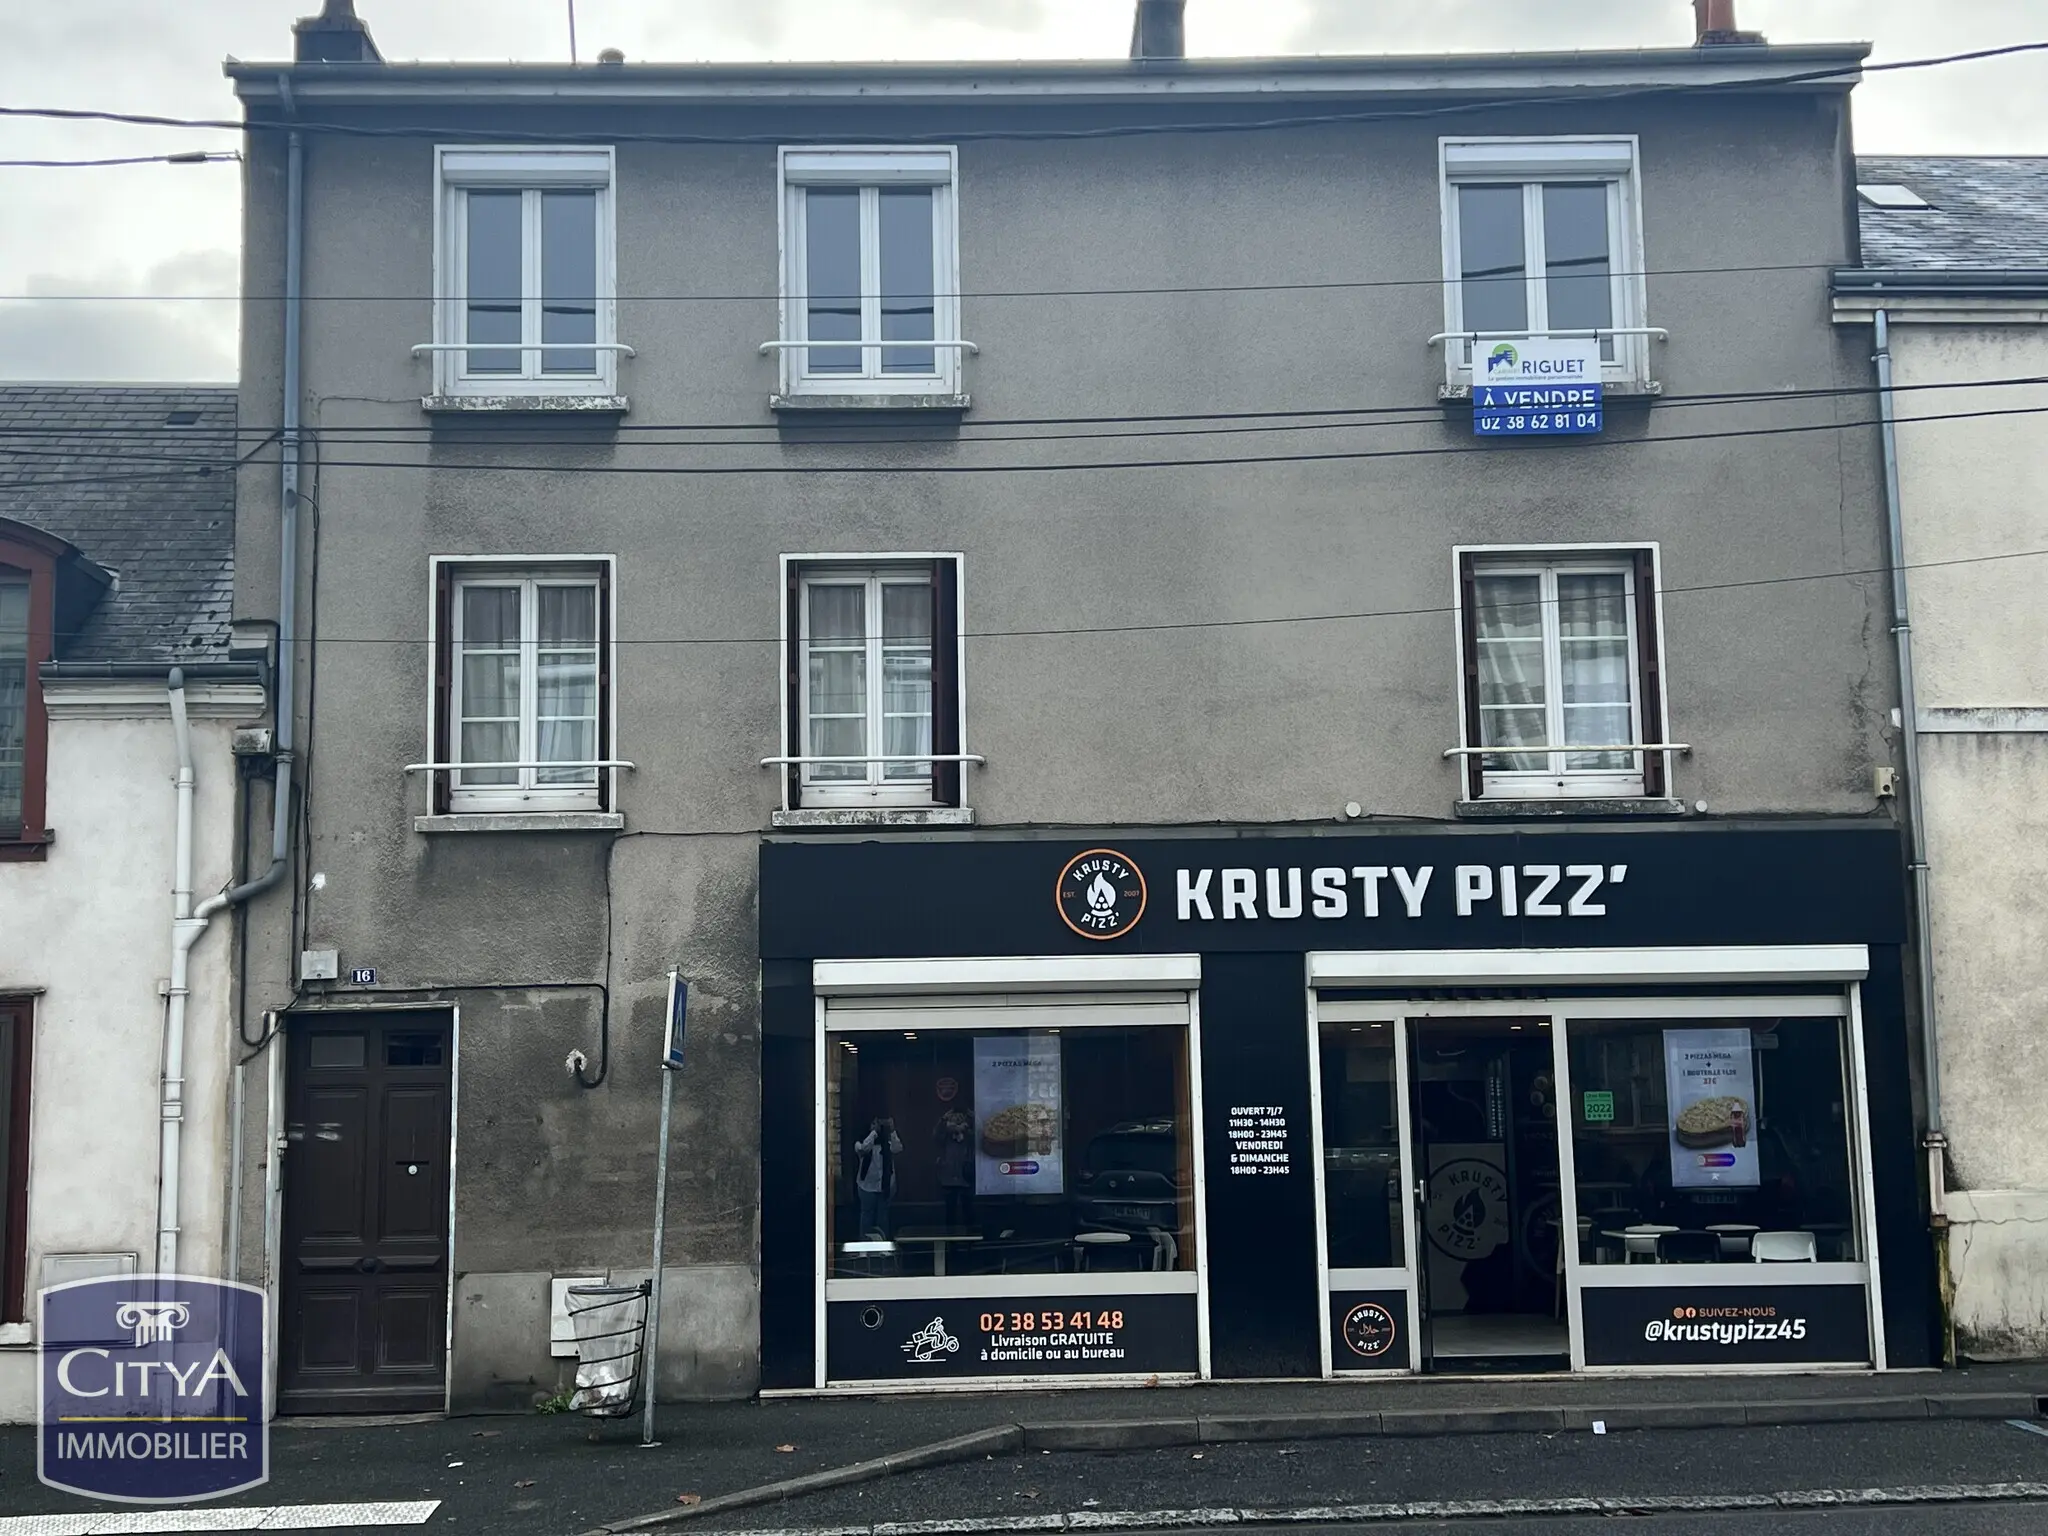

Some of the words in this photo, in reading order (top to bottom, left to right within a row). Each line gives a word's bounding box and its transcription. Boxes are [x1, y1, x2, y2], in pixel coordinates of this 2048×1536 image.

[1522, 358, 1584, 374] RIGUET
[1484, 388, 1494, 410] À
[1504, 389, 1596, 409] VENDRE
[1482, 416, 1500, 430] 02
[1507, 415, 1524, 430] 38
[1530, 414, 1548, 429] 62
[1554, 414, 1570, 428] 81
[1577, 413, 1596, 428] 04
[1072, 860, 1130, 881] KRUSTY
[1176, 865, 1434, 920] KRUSTY
[1456, 864, 1629, 918] PIZZ'
[1081, 912, 1120, 928] PIZZ'
[356, 970, 371, 982] 16
[1230, 1106, 1265, 1116] OUVERT
[1587, 1104, 1612, 1112] 2022
[1259, 1118, 1286, 1126] 14H30
[1228, 1130, 1254, 1138] 18H00
[1260, 1130, 1288, 1138] 23H45
[1236, 1140, 1284, 1150] VENDREDI
[1230, 1154, 1238, 1162] &
[1240, 1154, 1290, 1162] DIMANCHE
[1230, 1166, 1257, 1174] 18H00
[1263, 1166, 1290, 1174] 23H45
[1448, 1170, 1508, 1202] KRUSTY
[1699, 1308, 1776, 1318] SUIVEZ-NOUS
[980, 1313, 1005, 1332] 02
[1010, 1312, 1035, 1331] 38
[1041, 1312, 1064, 1330] 53
[1070, 1311, 1092, 1330] 41
[1096, 1311, 1124, 1330] 48
[1644, 1318, 1807, 1344] @krustypizz45
[991, 1334, 1047, 1347] Livraison
[1050, 1332, 1114, 1346] GRATUITE
[980, 1349, 988, 1360] à
[990, 1348, 1042, 1360] domicile
[1046, 1350, 1062, 1360] ou
[1064, 1349, 1080, 1360] au
[1082, 1347, 1124, 1359] bureau
